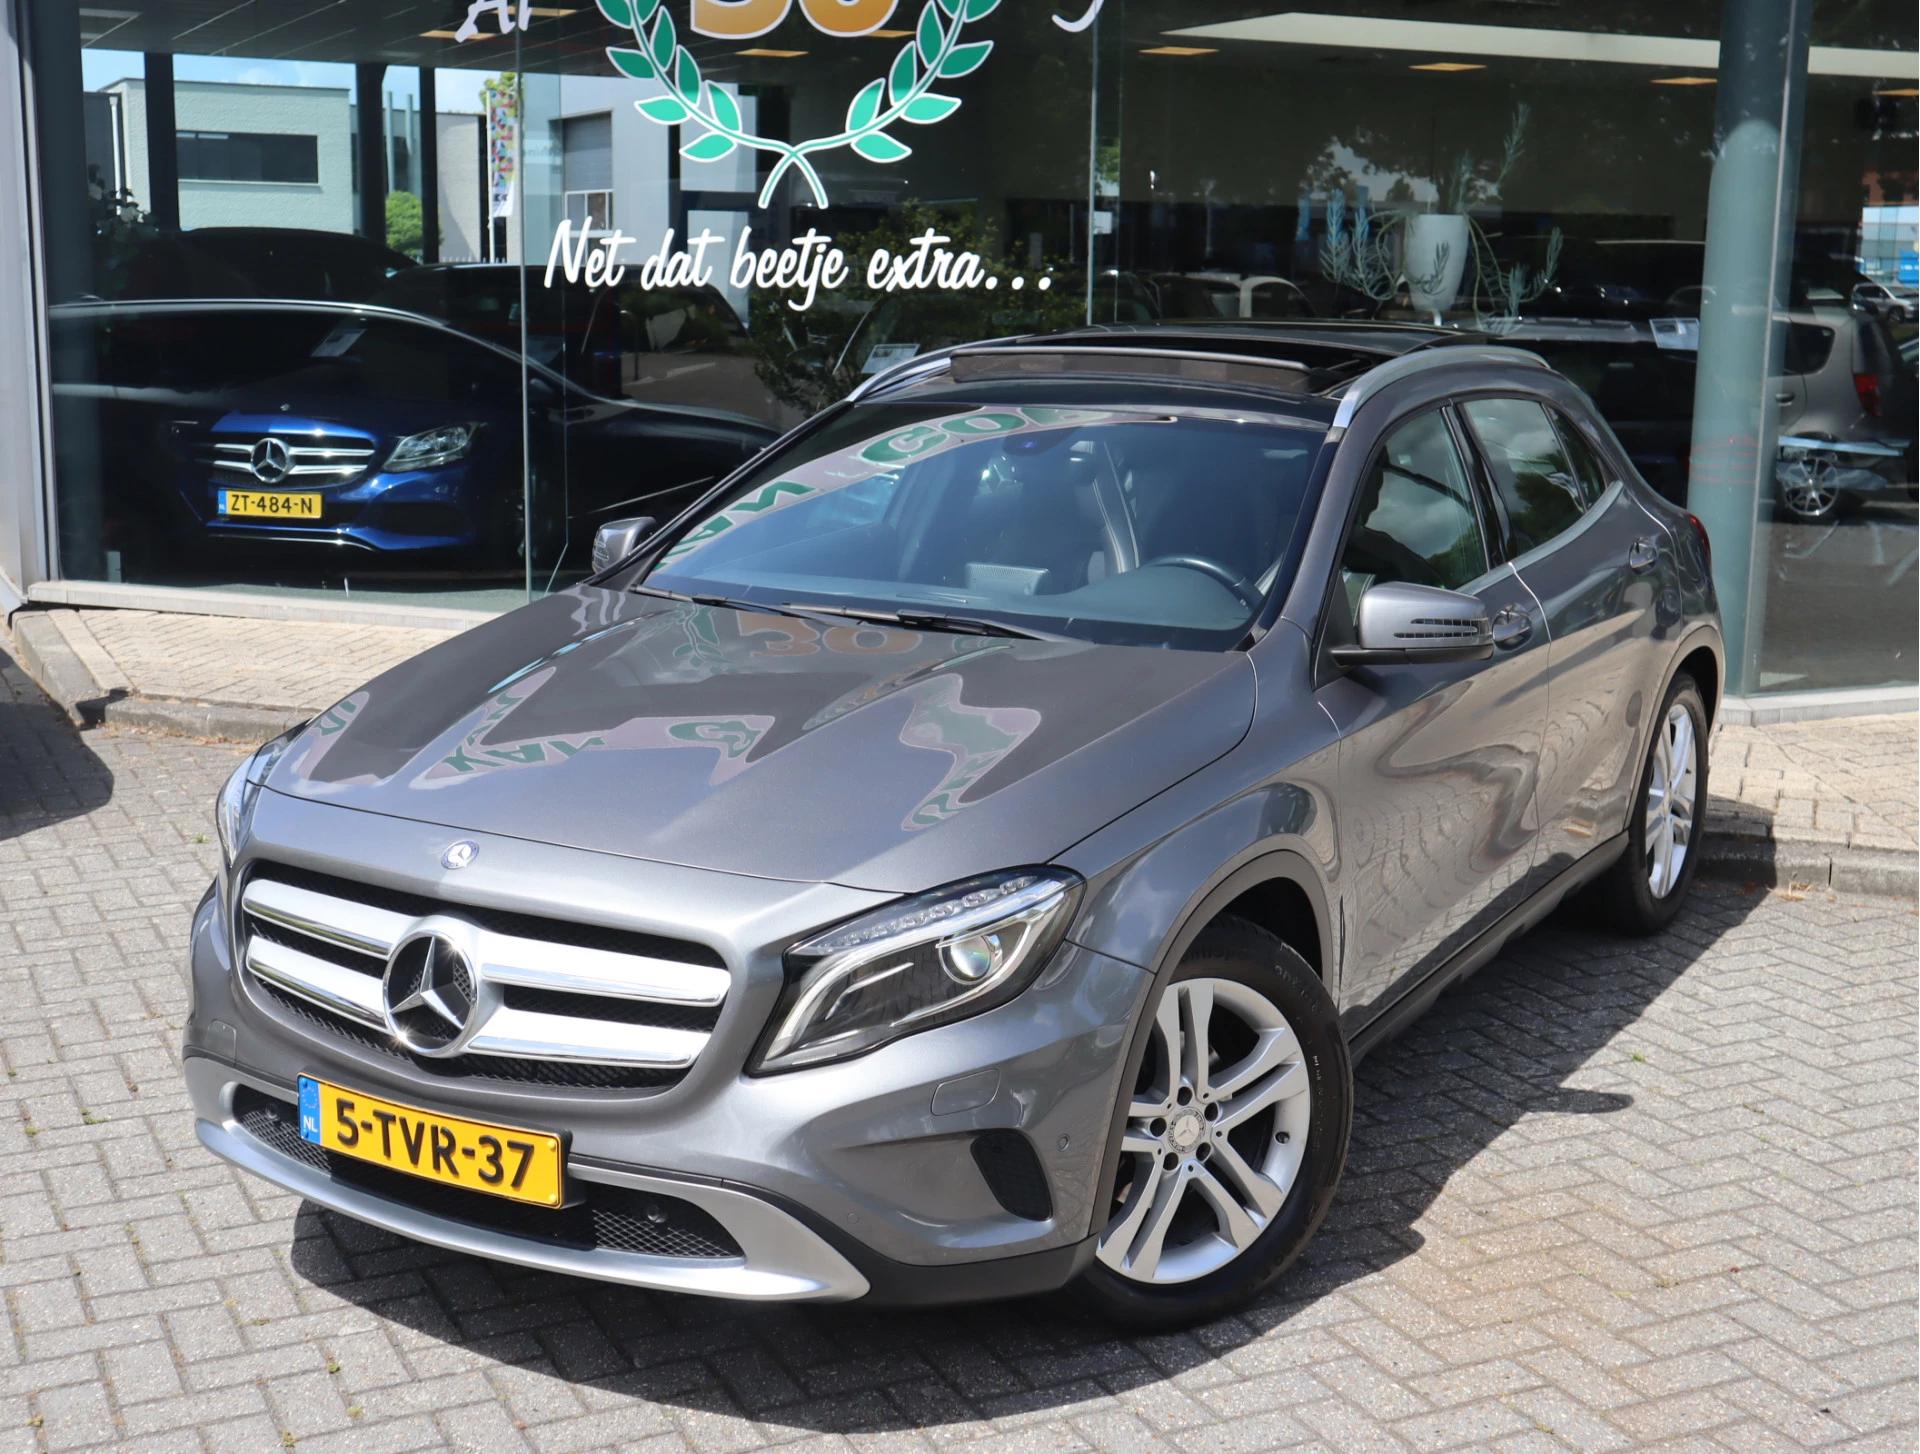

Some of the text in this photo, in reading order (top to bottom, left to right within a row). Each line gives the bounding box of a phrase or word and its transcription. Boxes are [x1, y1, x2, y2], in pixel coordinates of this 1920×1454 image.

[544, 217, 1052, 310] Net dat beetje extra...
[231, 494, 313, 514] ZT-484-N
[303, 1114, 318, 1132] NL
[336, 1098, 534, 1187] 5-TVR-37
